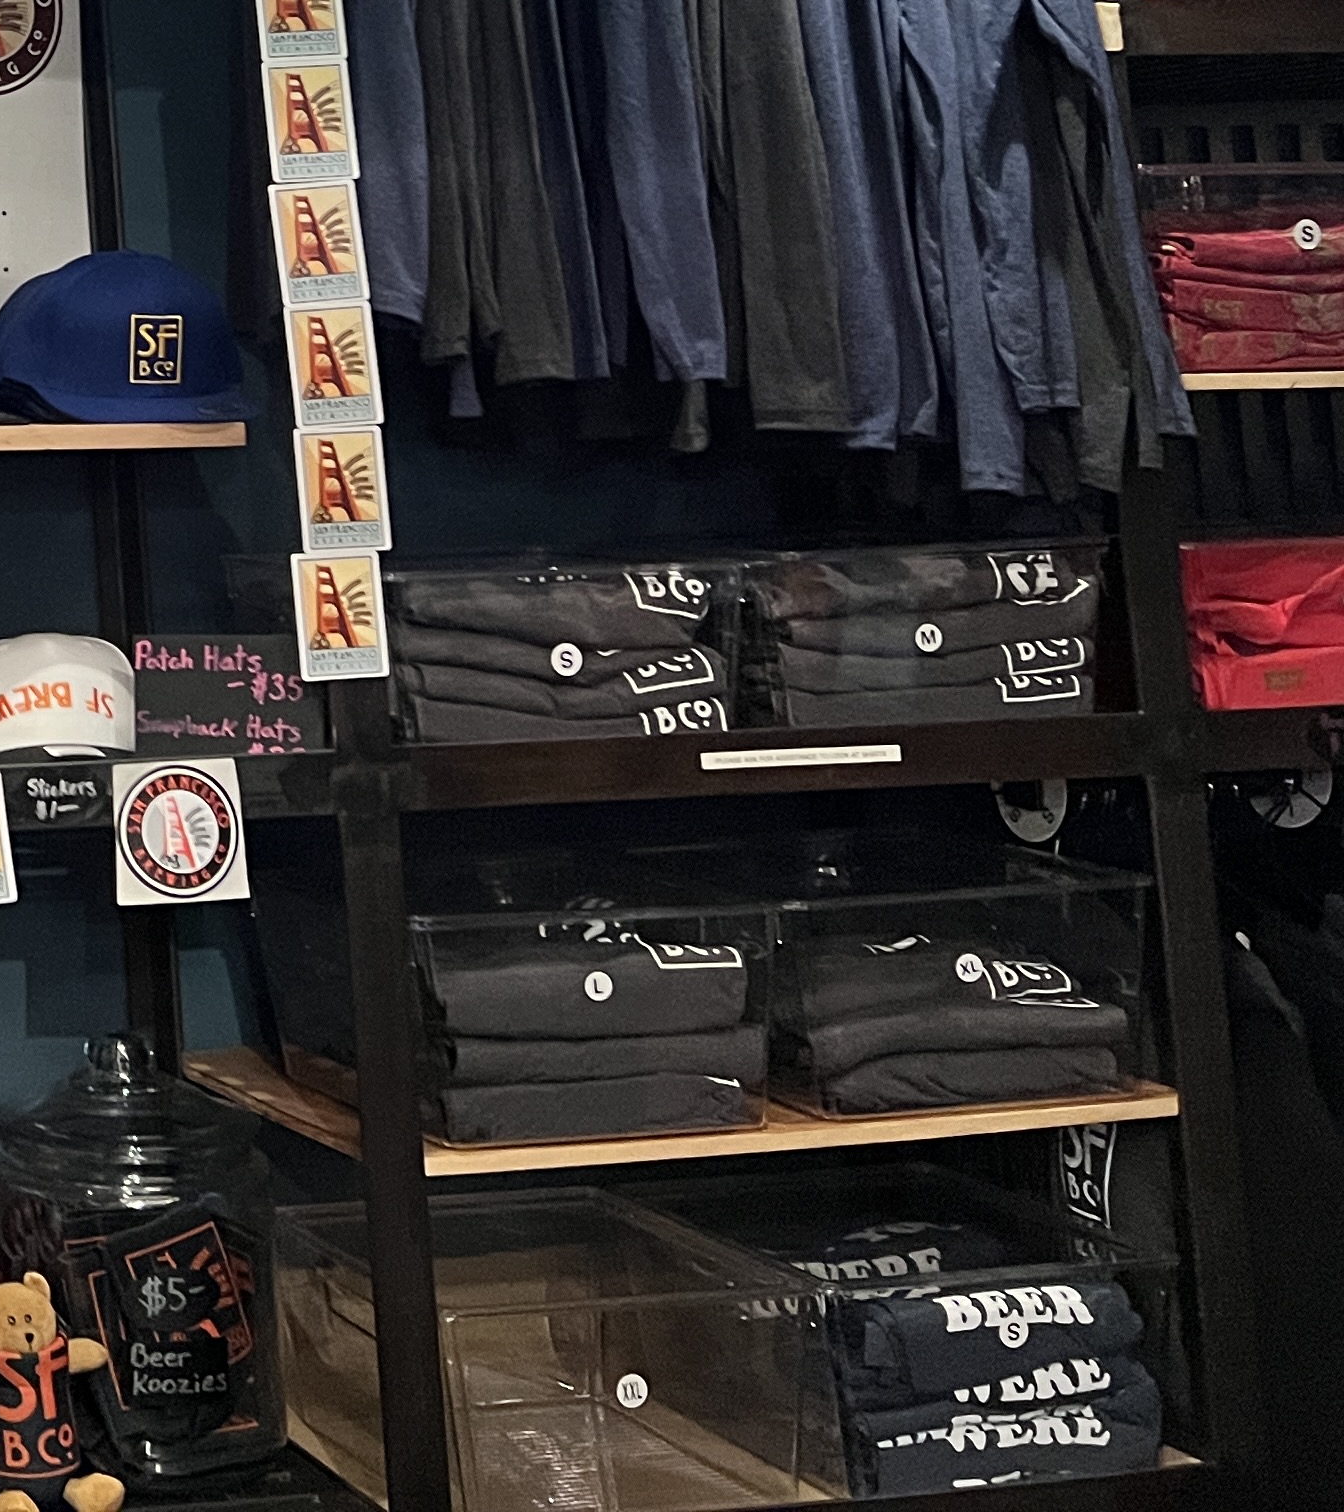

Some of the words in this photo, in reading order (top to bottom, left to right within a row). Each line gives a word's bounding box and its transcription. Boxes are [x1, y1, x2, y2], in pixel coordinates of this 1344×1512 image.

[136, 323, 177, 358] SF
[921, 630, 936, 644] M
[134, 640, 194, 671] Patch
[203, 644, 262, 673] Hats
[560, 653, 573, 666] S
[246, 714, 302, 744] Hats
[936, 1286, 1094, 1334] BEER
[130, 1343, 191, 1369] Beer
[132, 1371, 227, 1396] Koozies
